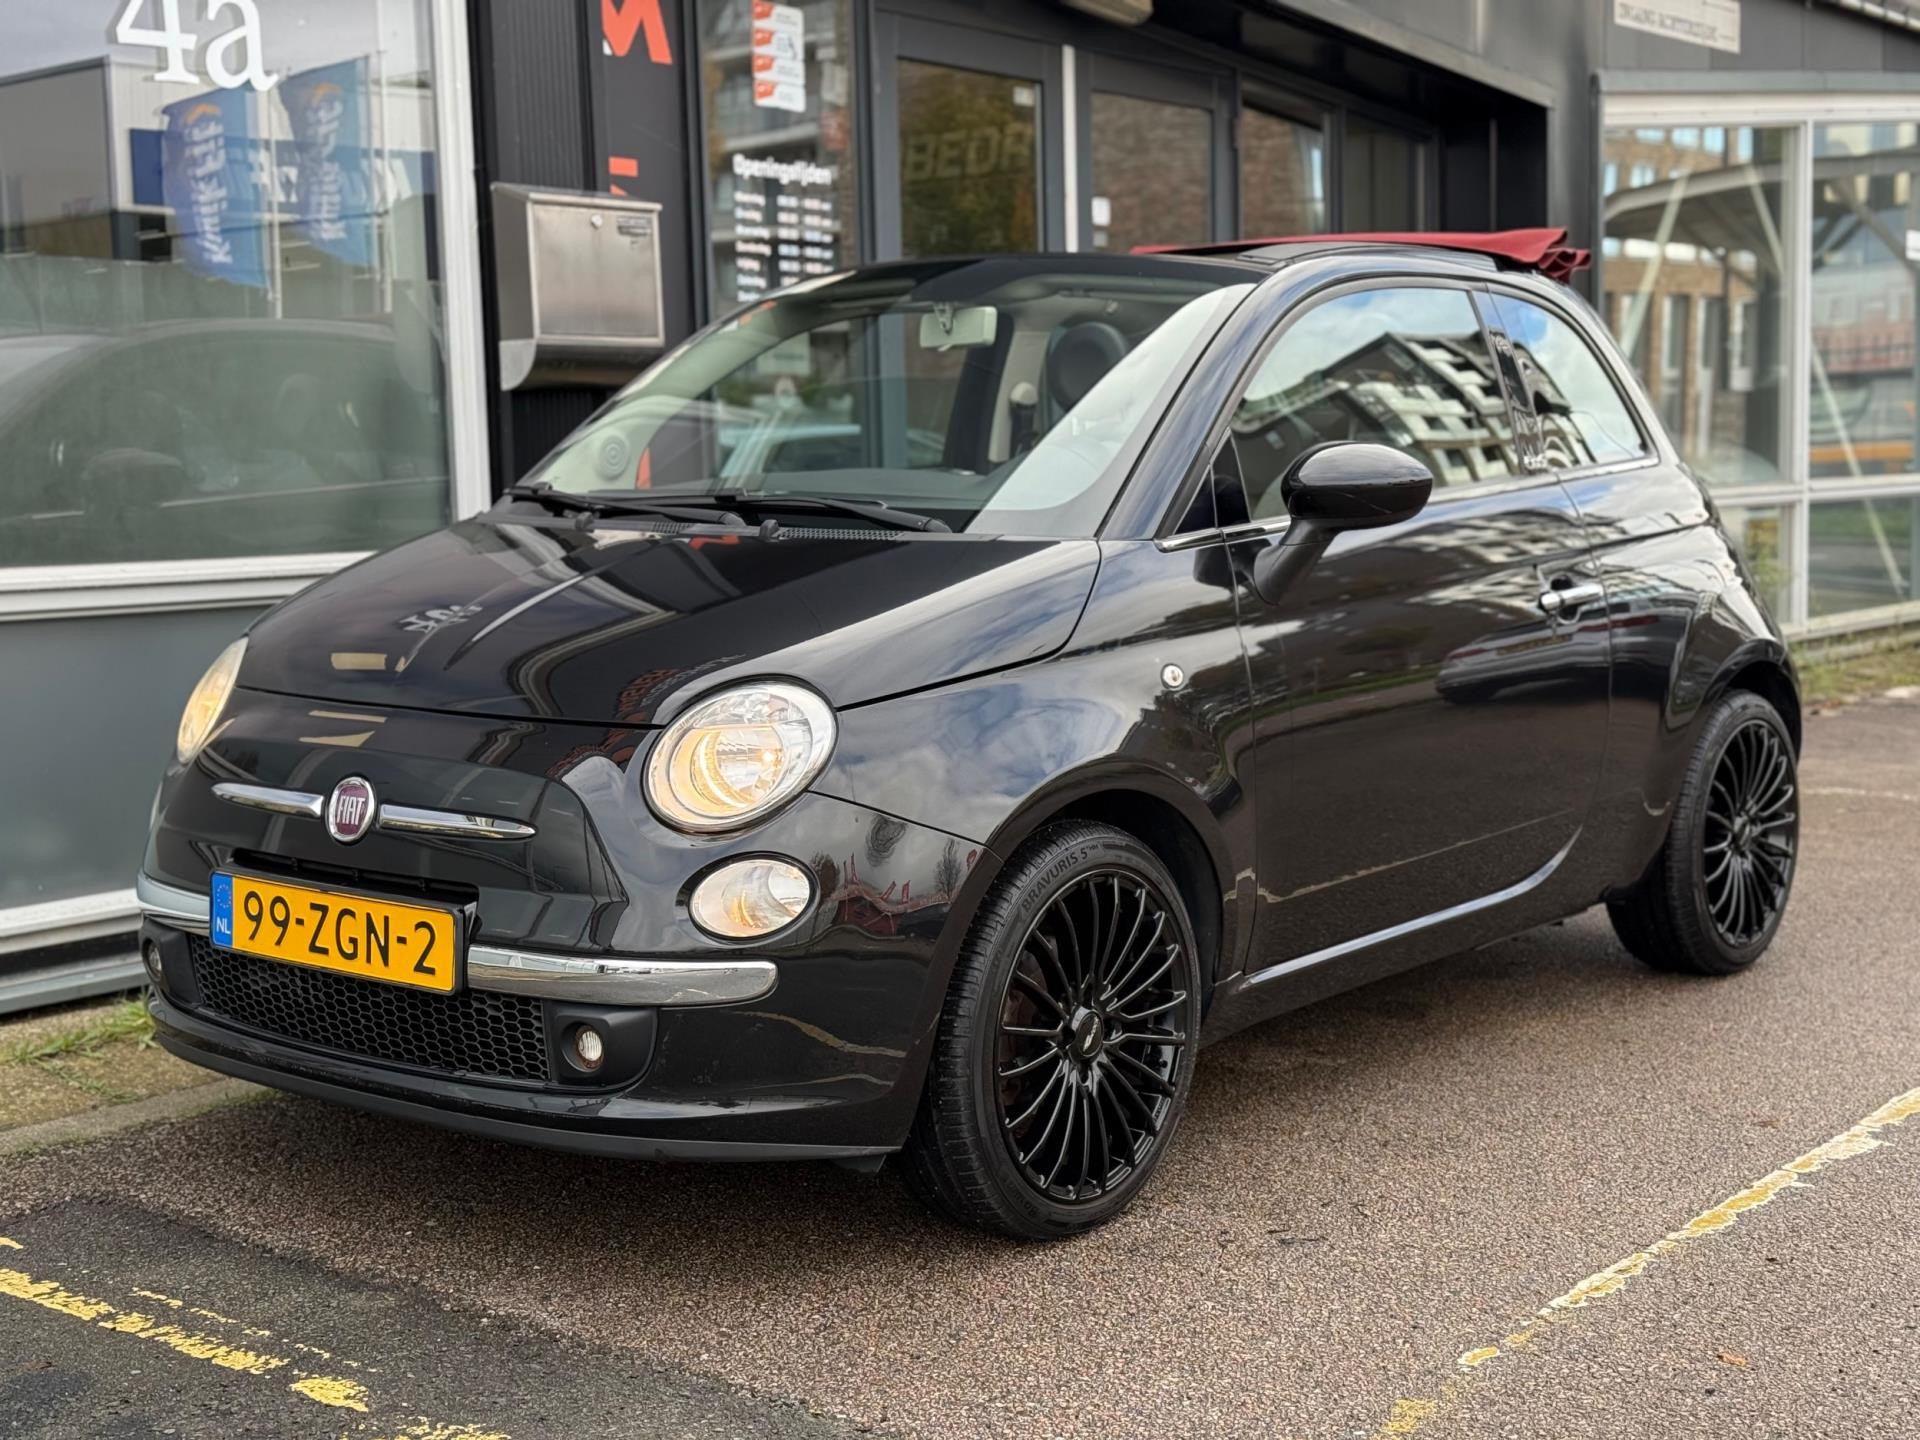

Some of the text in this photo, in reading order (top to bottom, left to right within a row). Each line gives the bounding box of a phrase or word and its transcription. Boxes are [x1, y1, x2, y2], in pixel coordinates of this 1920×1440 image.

[115, 0, 279, 91] 4a
[336, 795, 366, 826] FIAT
[1021, 852, 1079, 913] BRAVURIS
[216, 916, 232, 935] NL
[243, 890, 437, 976] 99-ZGN-2
